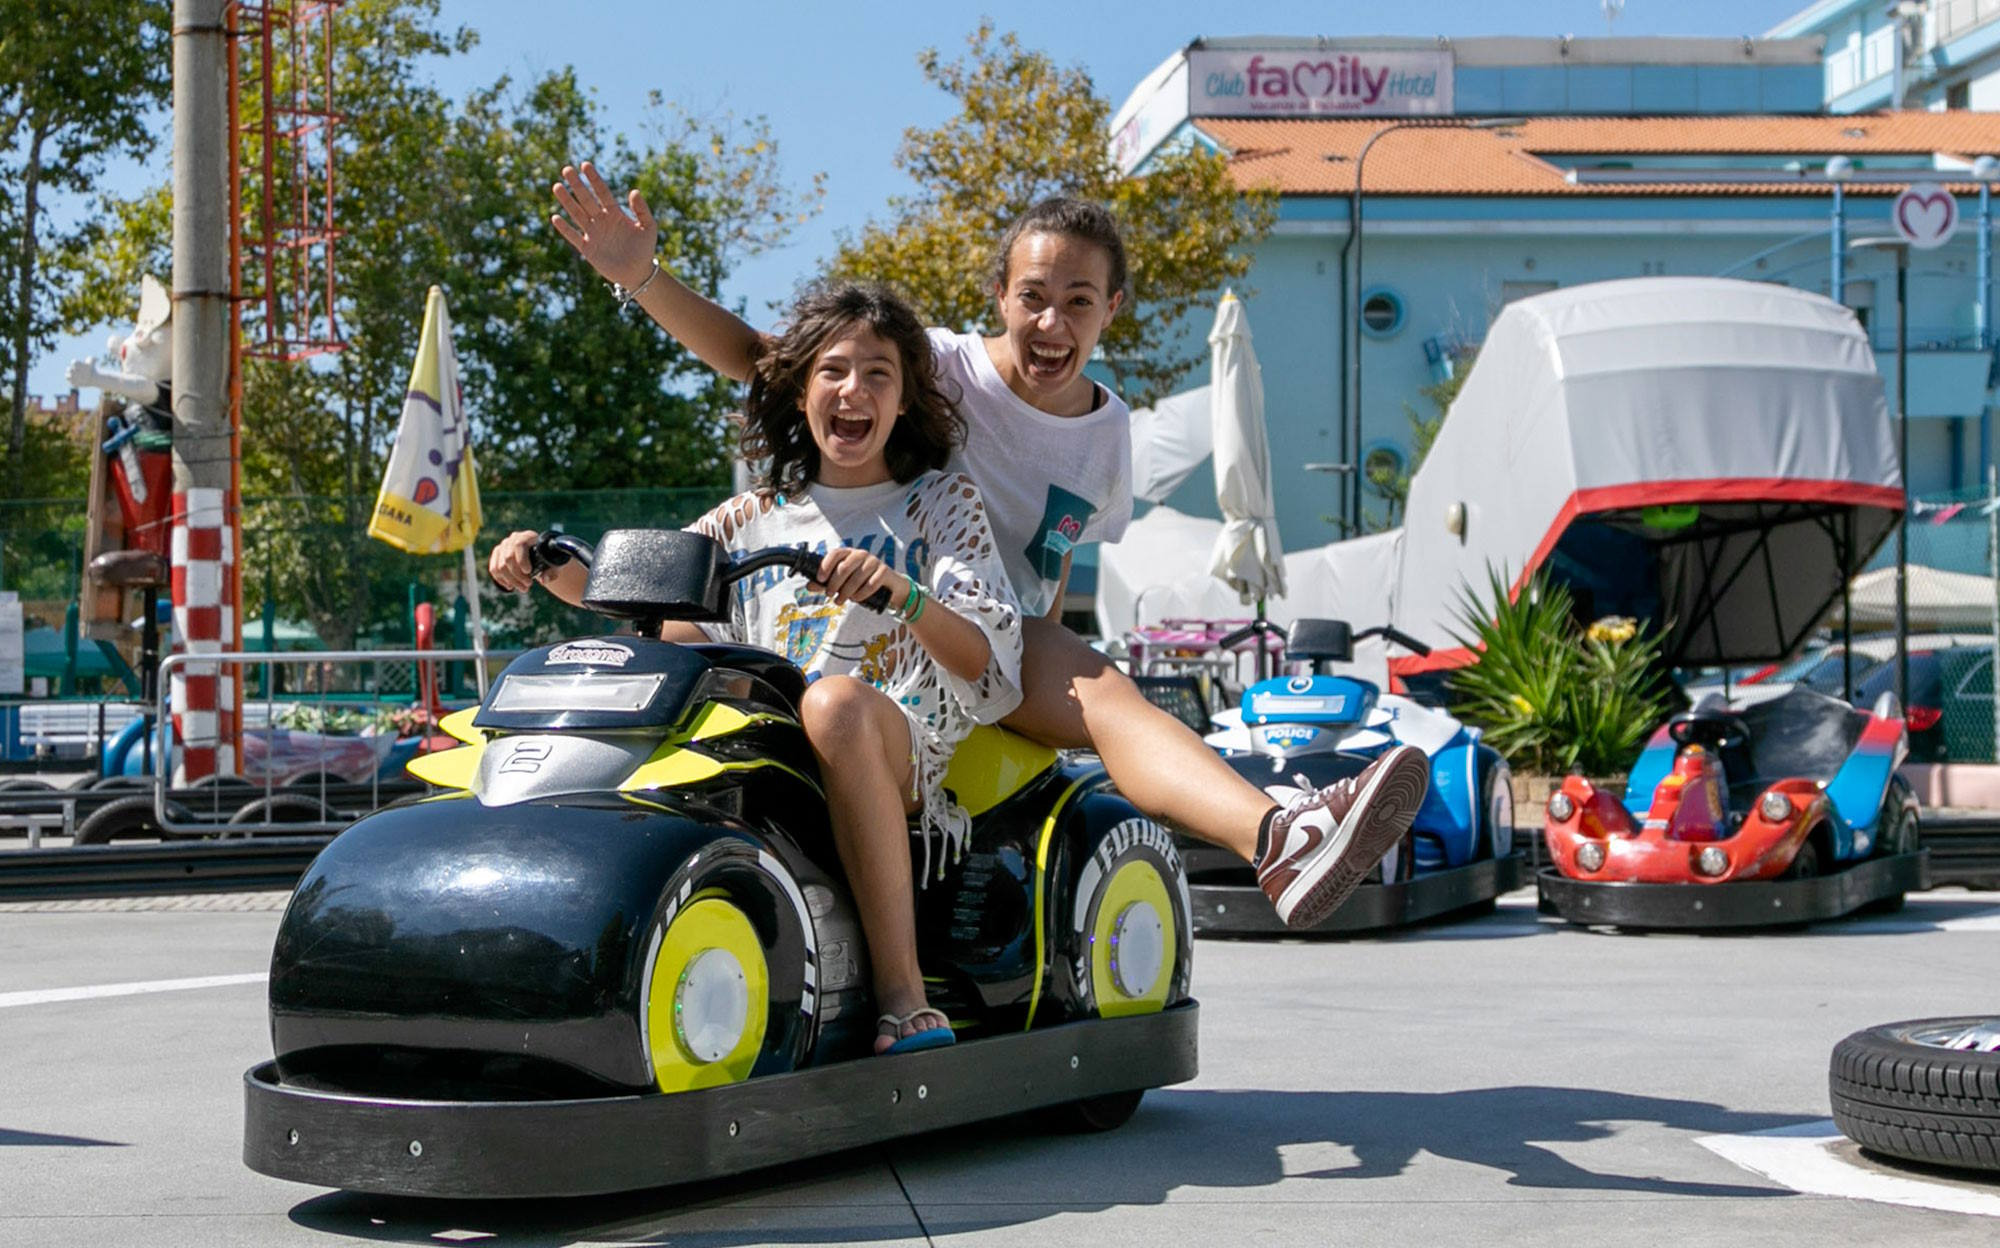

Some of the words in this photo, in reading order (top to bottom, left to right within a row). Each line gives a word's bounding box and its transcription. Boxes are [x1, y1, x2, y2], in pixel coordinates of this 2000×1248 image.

[1206, 72, 1245, 98] Club
[1247, 55, 1389, 104] family
[1389, 70, 1437, 98] Hotel
[1266, 727, 1314, 741] POLICE
[499, 740, 553, 774] 2
[1098, 817, 1182, 872] FUTURE
